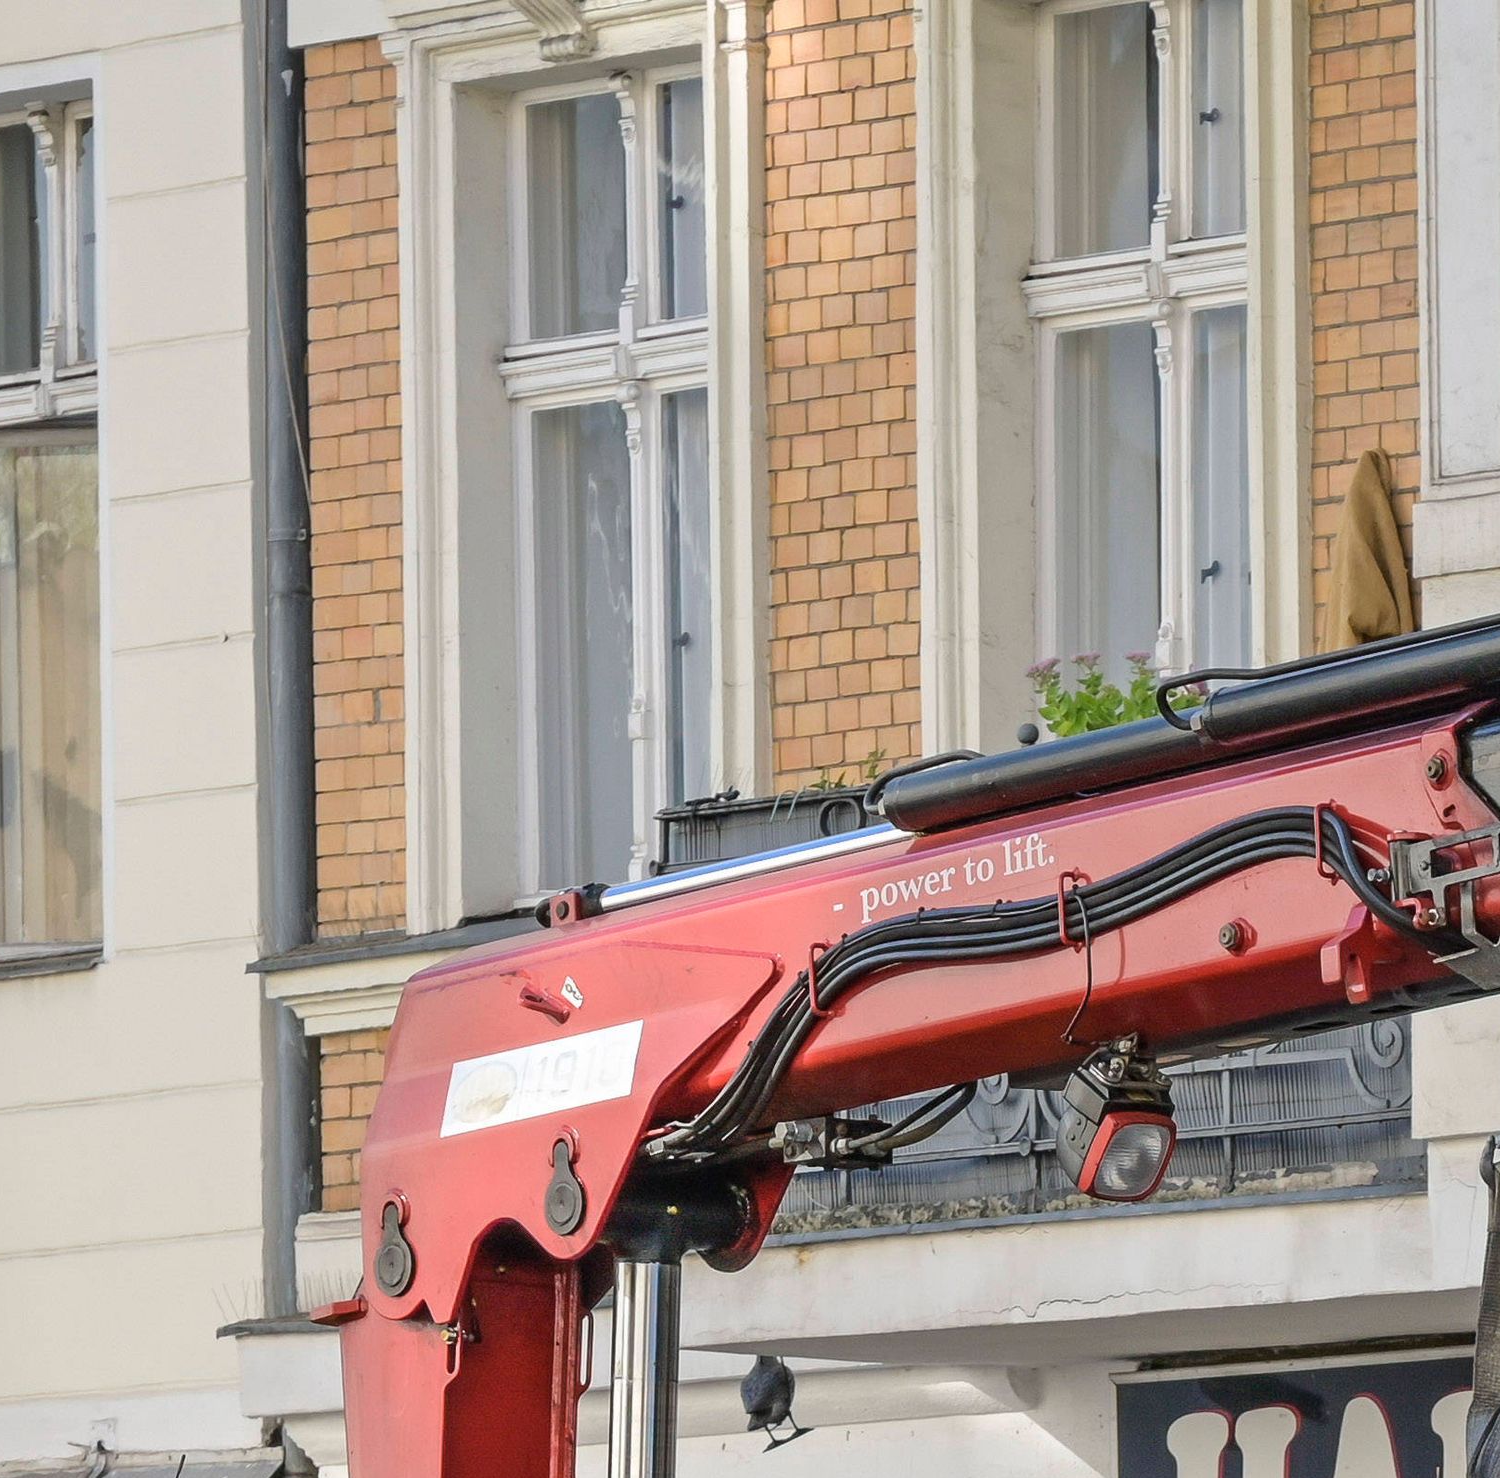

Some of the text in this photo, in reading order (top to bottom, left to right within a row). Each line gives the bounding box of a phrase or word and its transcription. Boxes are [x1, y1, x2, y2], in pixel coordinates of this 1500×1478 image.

[859, 834, 1055, 924] power to lift.
